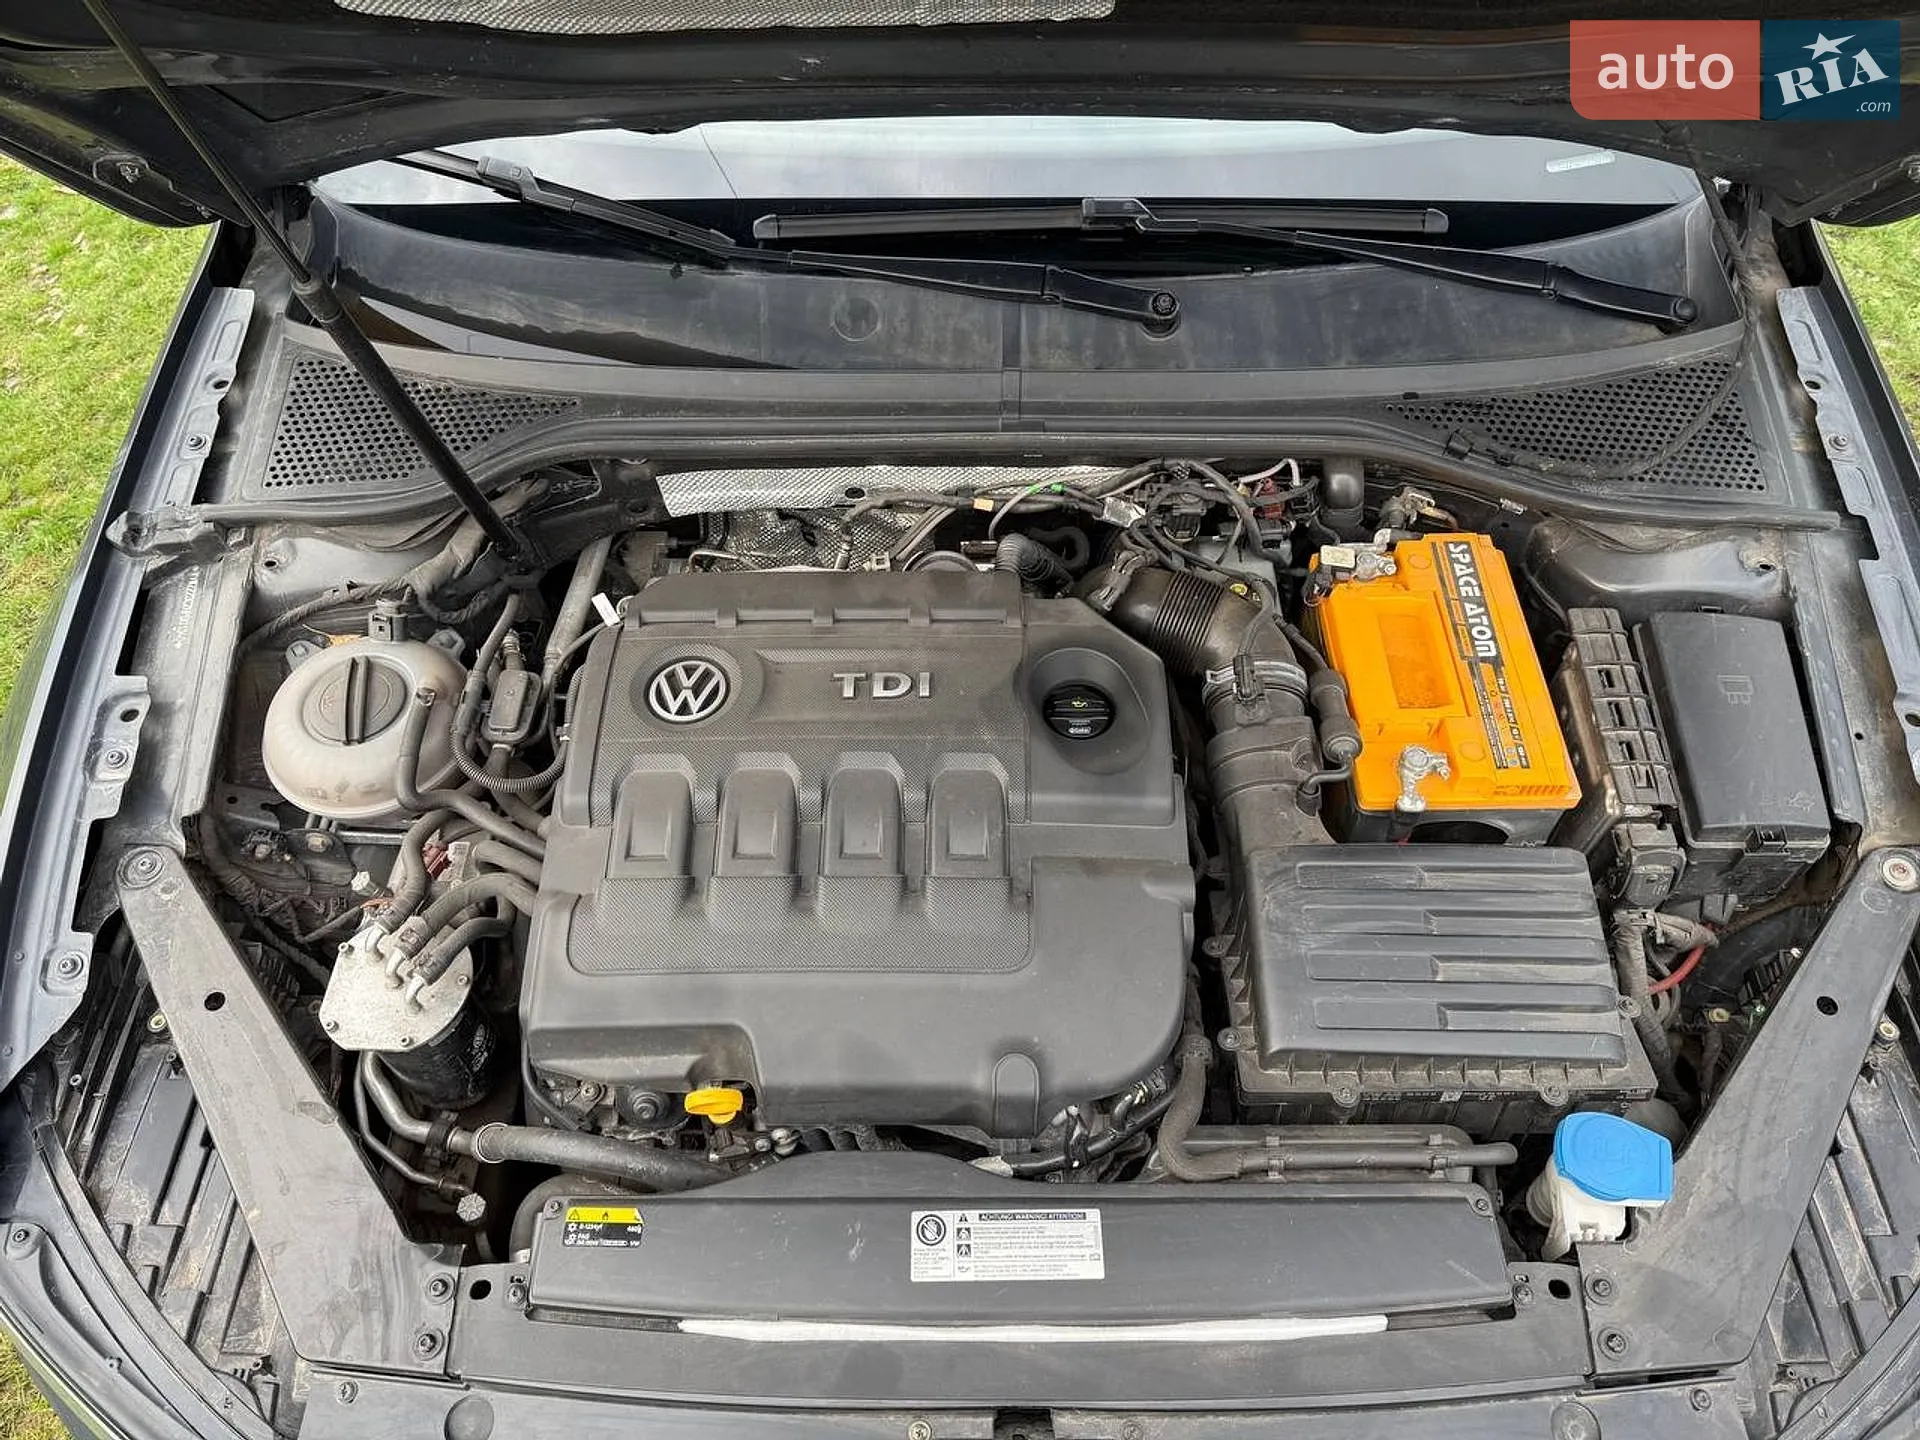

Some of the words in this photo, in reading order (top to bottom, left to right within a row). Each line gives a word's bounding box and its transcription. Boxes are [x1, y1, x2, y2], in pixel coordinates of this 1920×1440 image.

[1448, 543, 1481, 597] SPACE
[1464, 602, 1497, 657] ATOM
[833, 672, 931, 698] TDI
